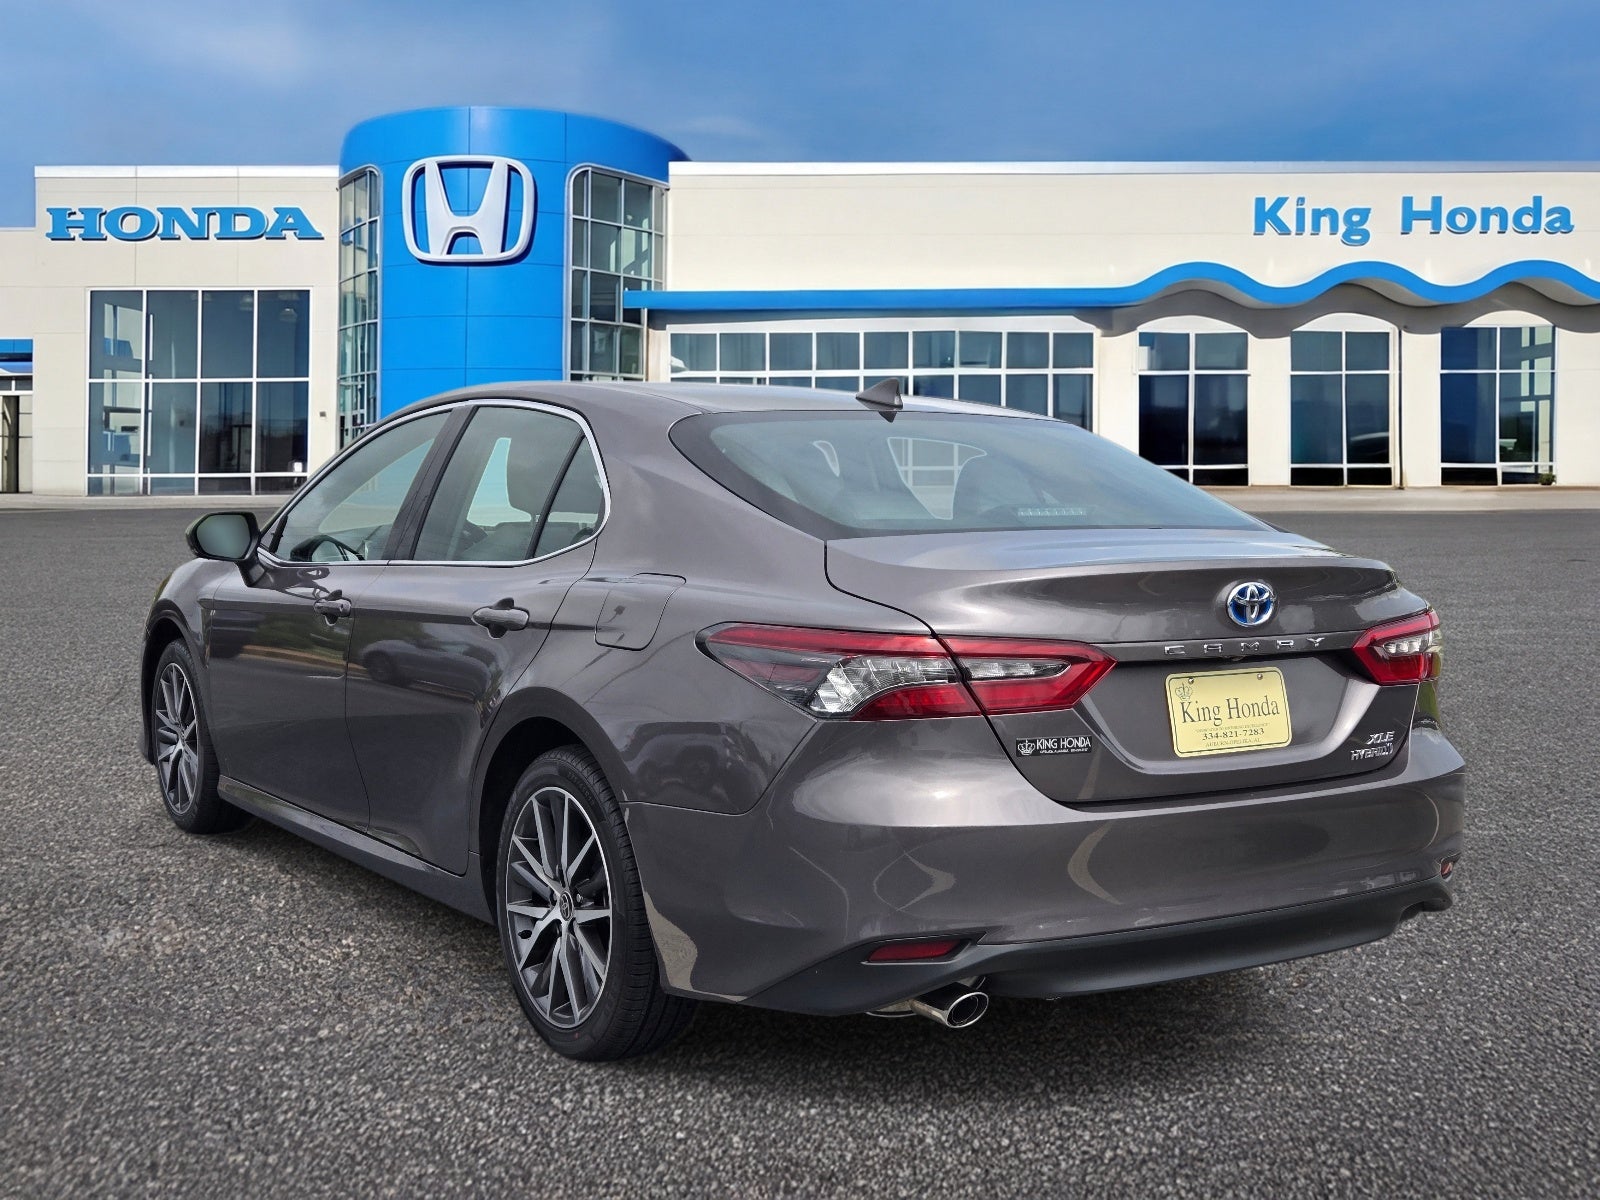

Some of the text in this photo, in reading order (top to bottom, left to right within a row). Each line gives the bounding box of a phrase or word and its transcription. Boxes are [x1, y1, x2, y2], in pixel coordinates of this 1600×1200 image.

[46, 206, 325, 241] HONDA
[1253, 195, 1575, 246] King Honda
[1164, 637, 1326, 655] CAMRY
[1180, 695, 1280, 727] King Honda
[1036, 736, 1091, 750] KING HONDA
[1202, 727, 1265, 741] 334-821-7283
[1366, 731, 1395, 745] XLE
[1350, 742, 1394, 760] HYBRID
